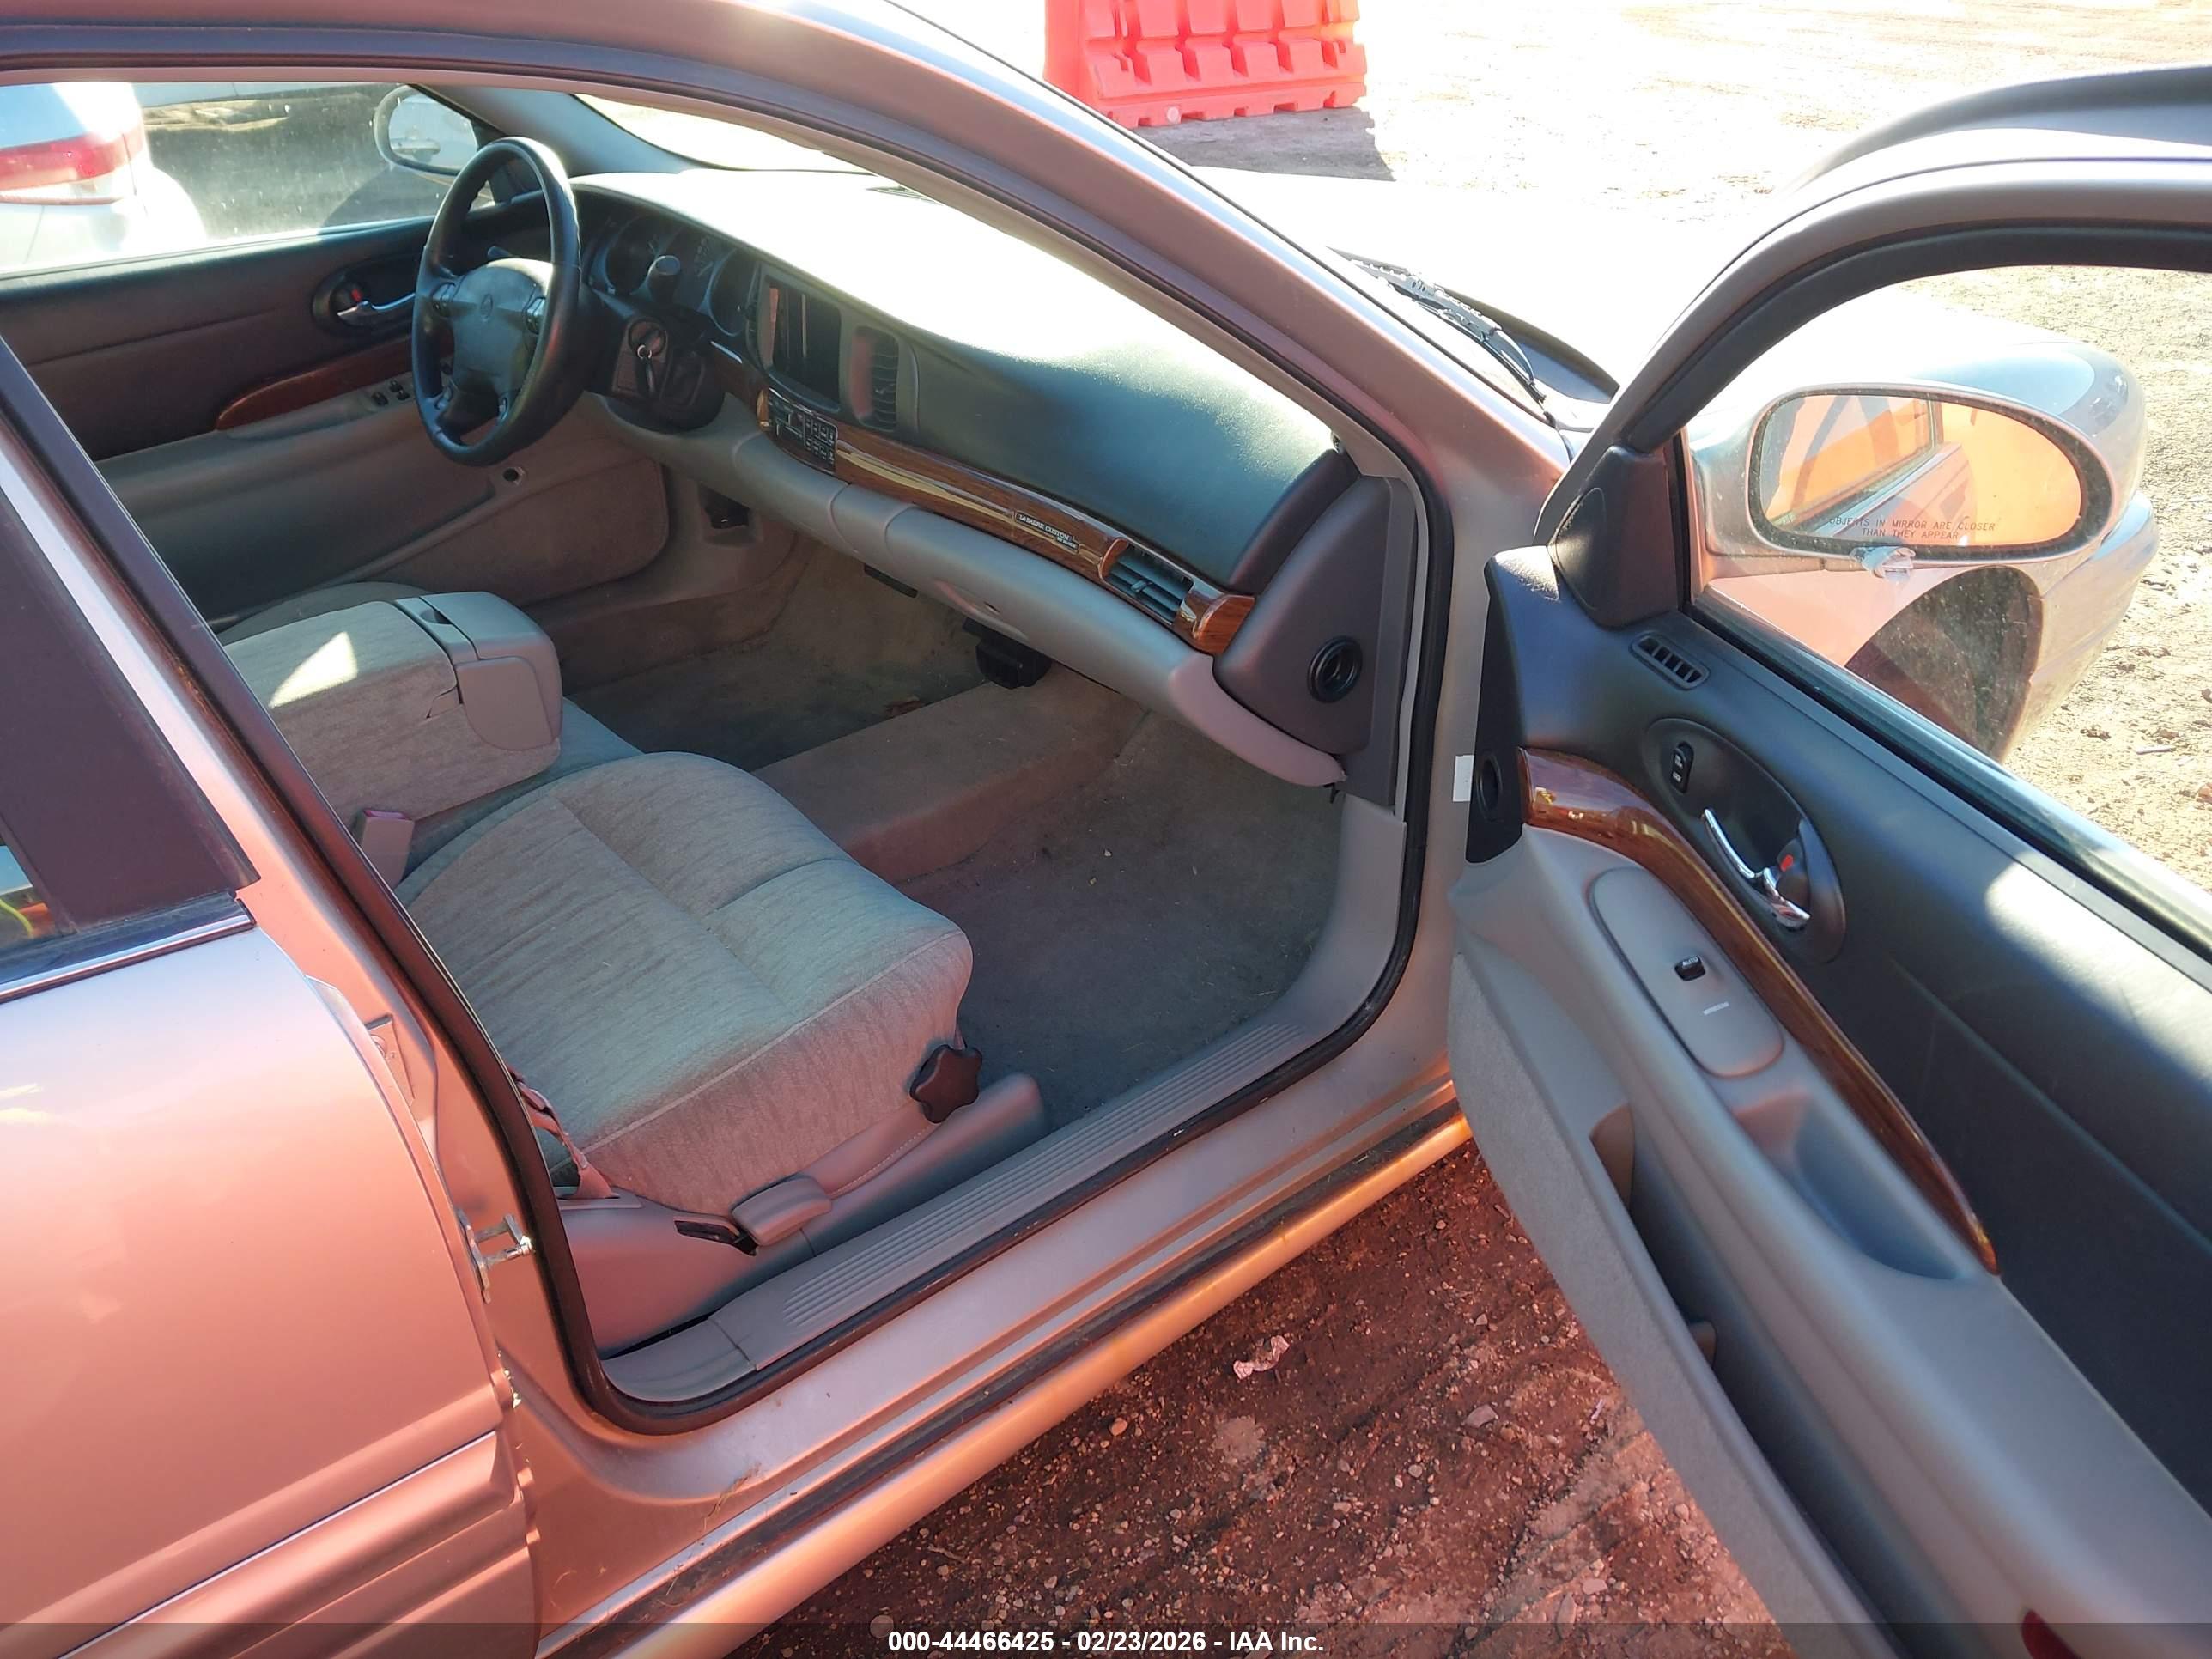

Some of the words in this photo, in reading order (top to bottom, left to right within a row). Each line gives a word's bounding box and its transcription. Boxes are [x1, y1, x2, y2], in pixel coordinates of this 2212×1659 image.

[1876, 519, 1886, 527] IN
[1893, 519, 1927, 529] MIRROR
[1933, 521, 1952, 530] ARE
[1958, 521, 1996, 531] CLOSER
[1045, 526, 1073, 542] CUSTOM
[1863, 527, 1886, 537] THAN
[1893, 529, 1916, 538] THEY
[1921, 530, 1959, 539] APPEAR
